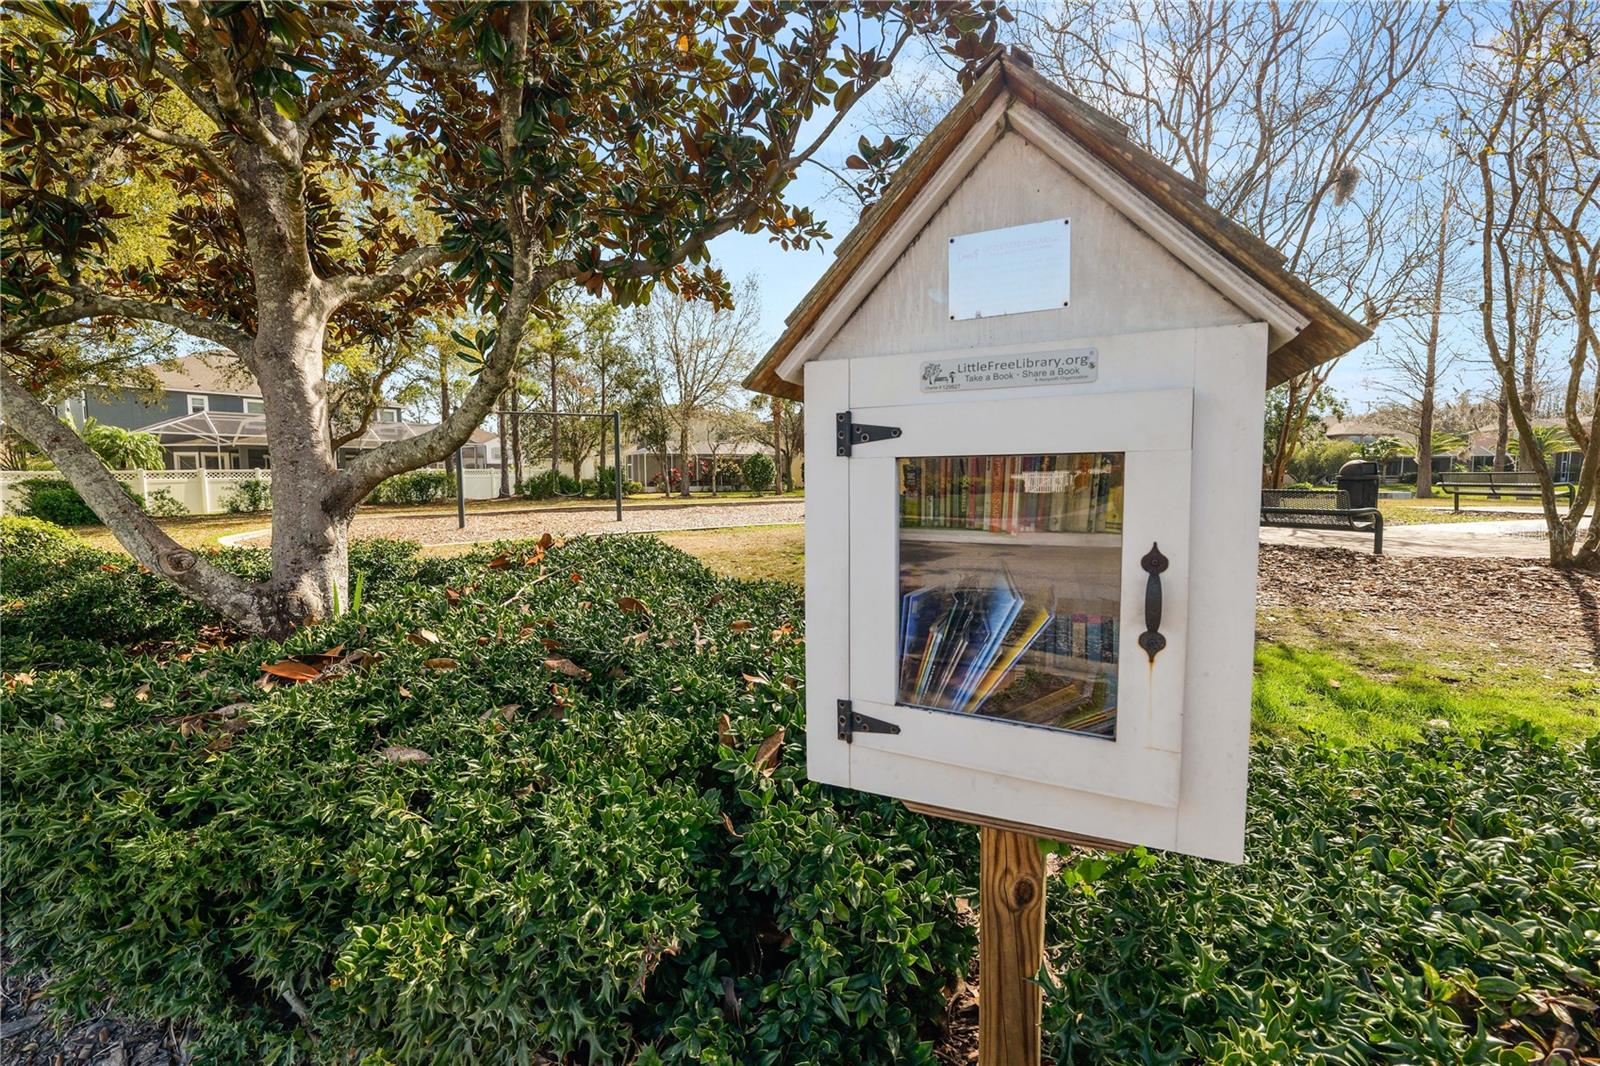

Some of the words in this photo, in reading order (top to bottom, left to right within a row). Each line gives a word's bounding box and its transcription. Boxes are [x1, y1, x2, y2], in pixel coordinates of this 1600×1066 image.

[957, 356, 1088, 373] LittleFreeLibrary.org
[965, 374, 983, 383] Take
[993, 371, 1014, 381] Book
[1022, 370, 1047, 378] Share
[1057, 367, 1080, 376] Book
